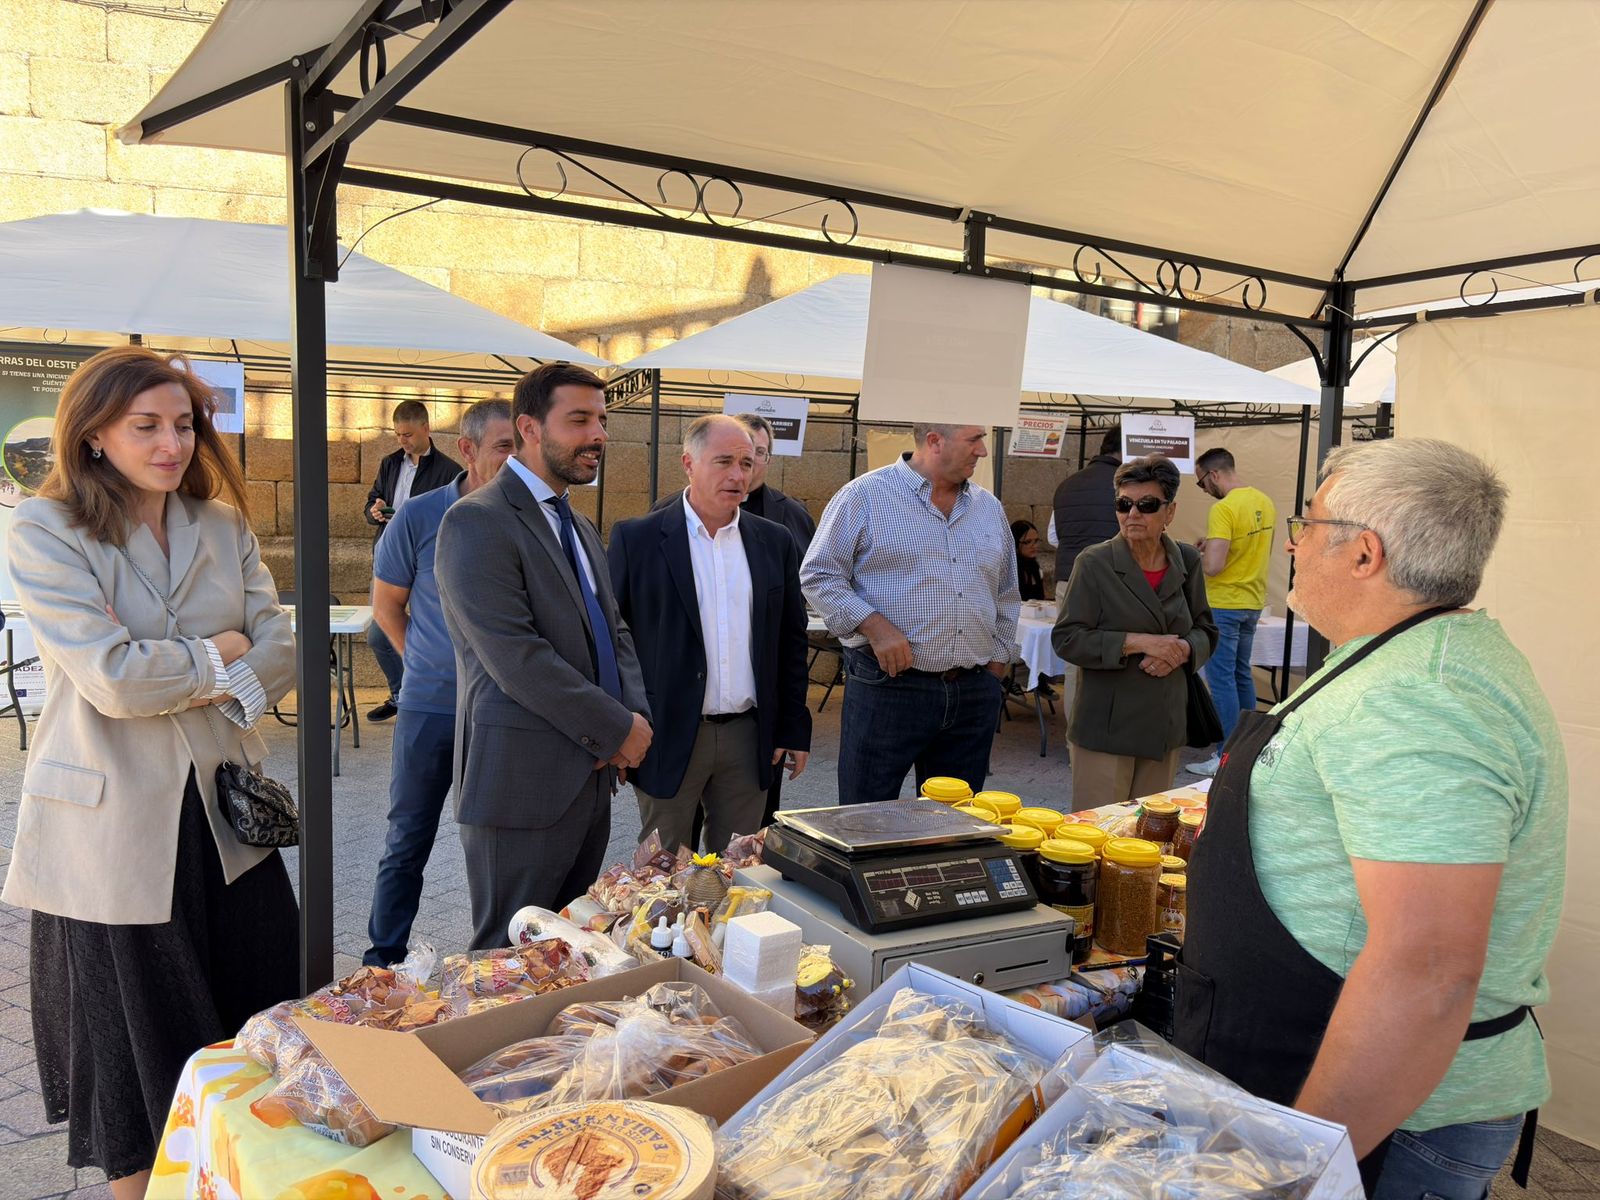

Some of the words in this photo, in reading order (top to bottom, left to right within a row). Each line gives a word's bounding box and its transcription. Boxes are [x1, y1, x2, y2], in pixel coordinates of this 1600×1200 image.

[26, 358, 45, 368] DEL
[46, 359, 77, 370] OESTE
[1023, 420, 1055, 429] PRECIOS
[430, 1135, 442, 1152] SIN
